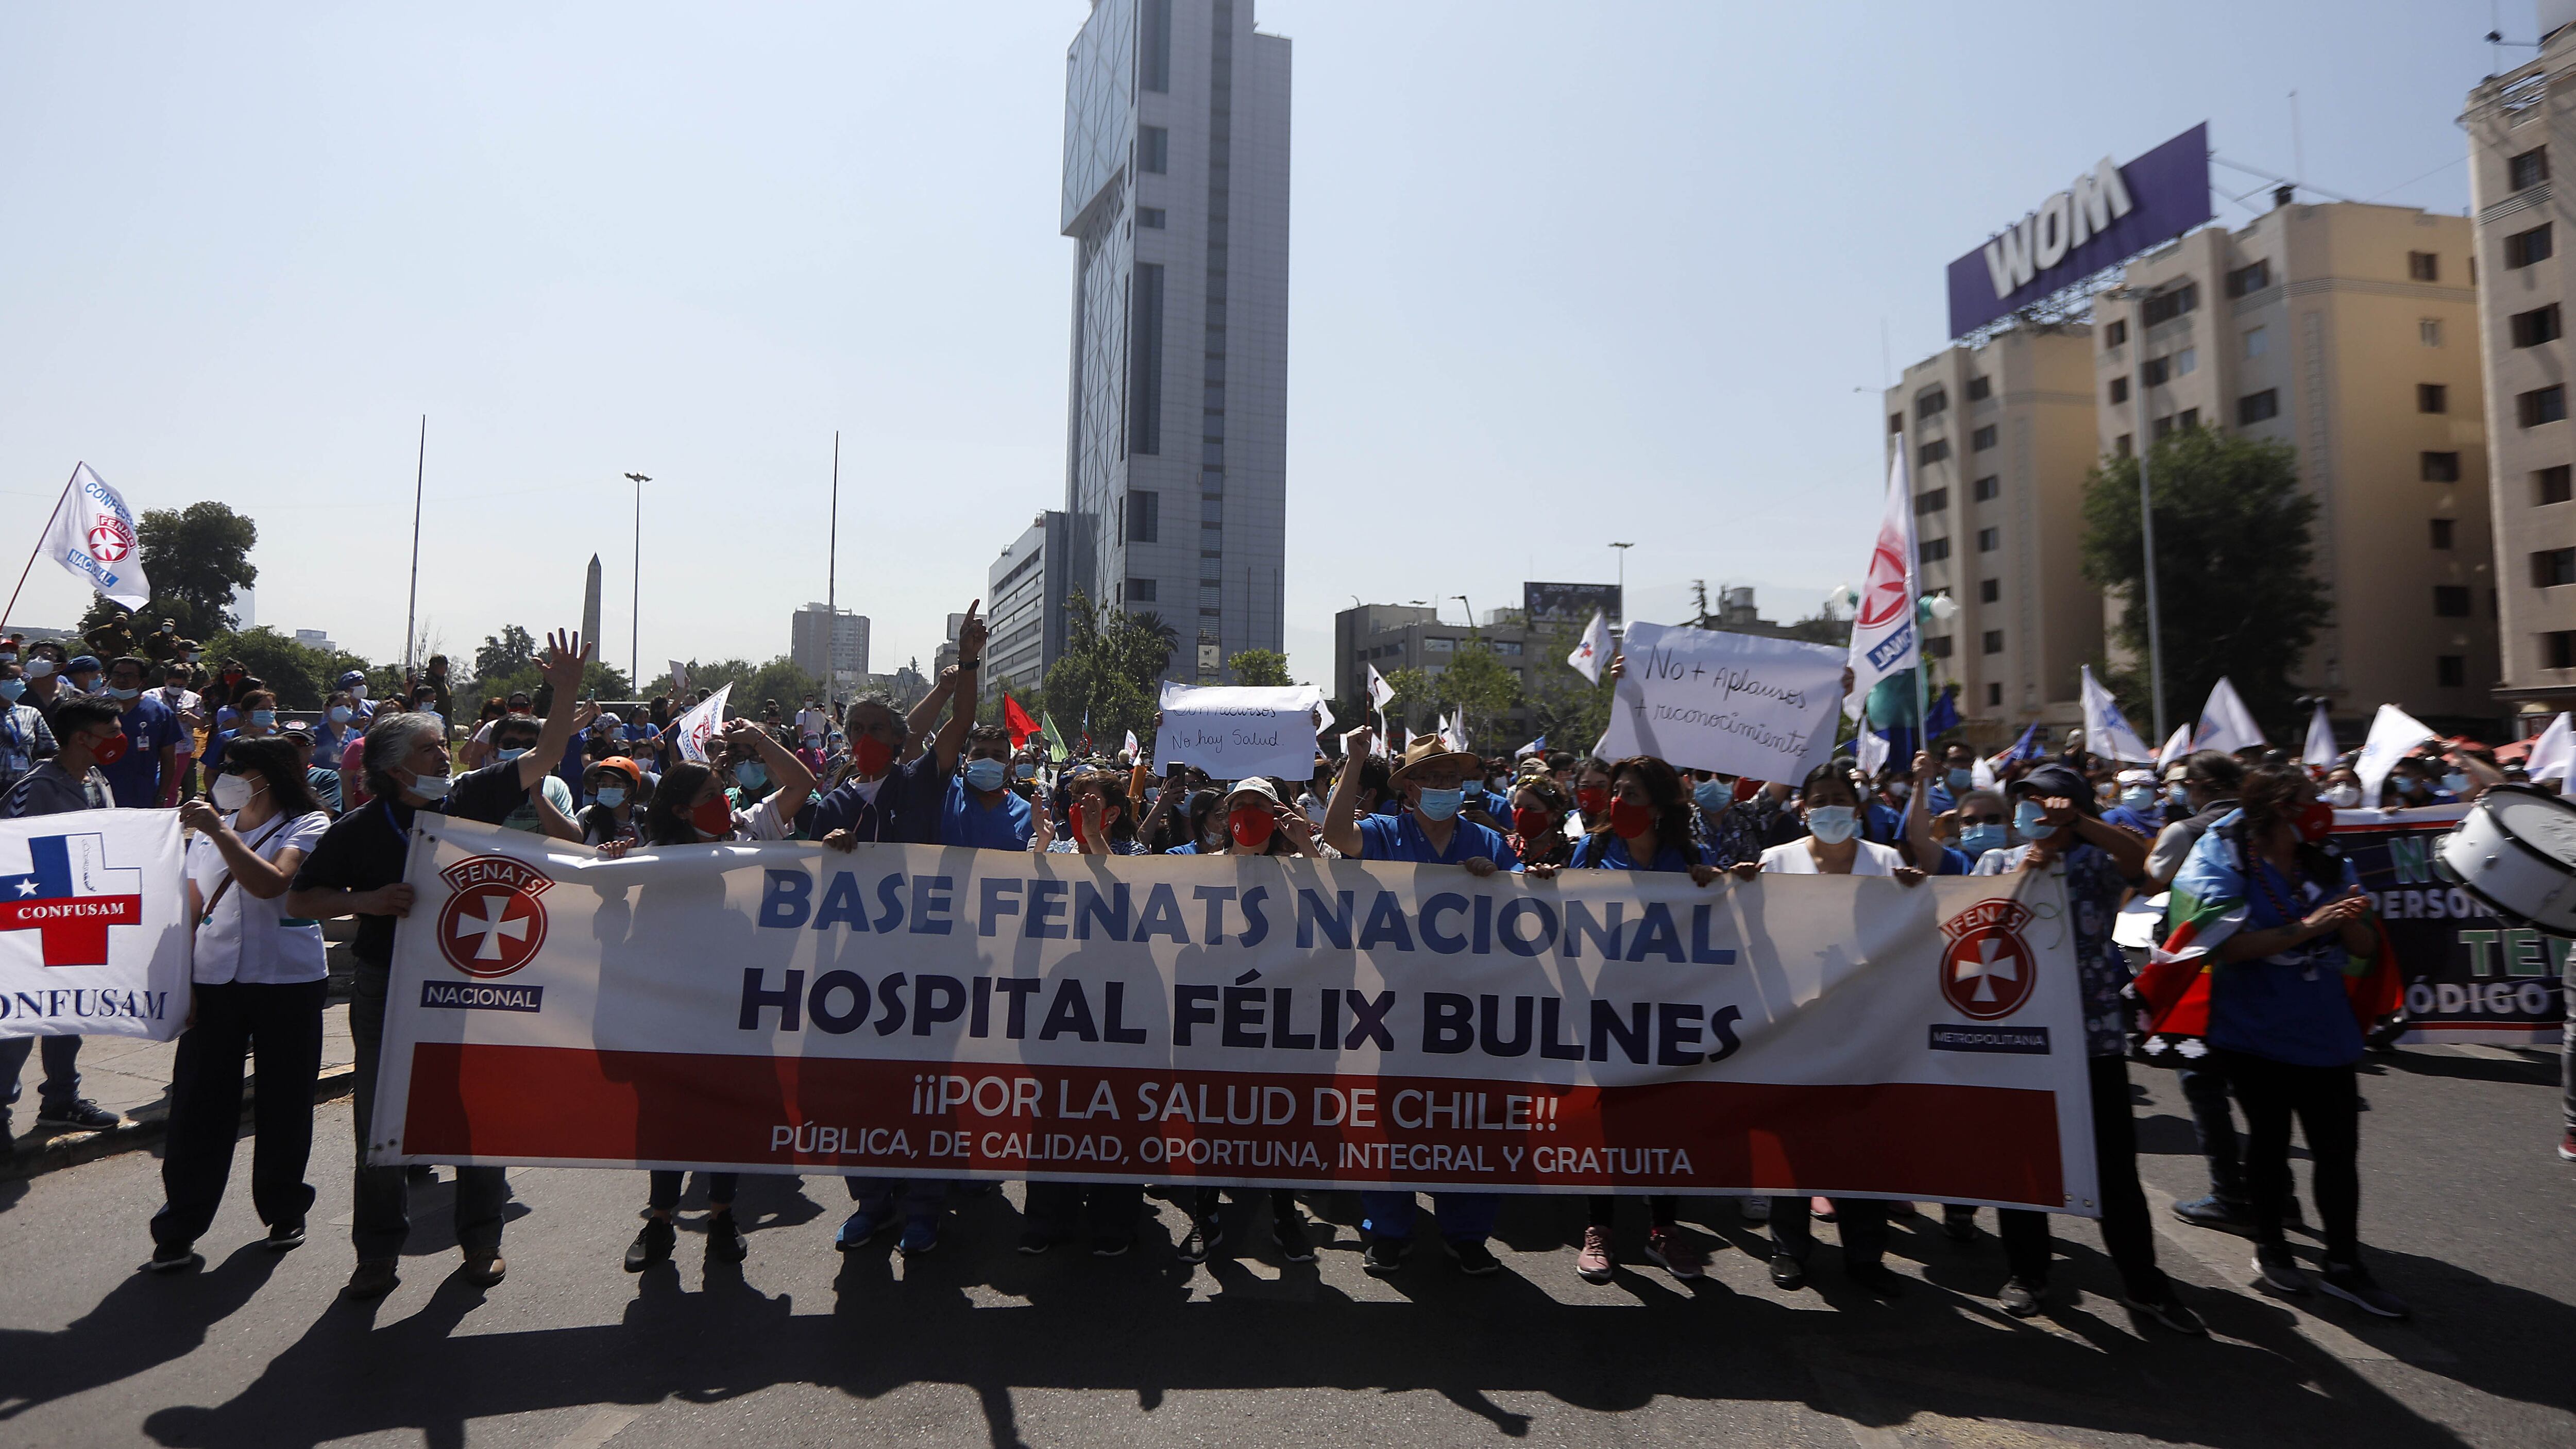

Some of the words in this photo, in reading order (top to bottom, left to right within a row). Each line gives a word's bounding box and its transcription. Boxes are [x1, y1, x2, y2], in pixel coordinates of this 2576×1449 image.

[1984, 155, 2133, 300] WOM
[1646, 645, 1684, 680] No
[1691, 661, 1705, 681] +
[1173, 697, 1209, 716] Sin
[1214, 704, 1276, 718] recursos
[1172, 730, 1190, 749] No
[1196, 729, 1223, 753] hay
[1232, 729, 1284, 747] Salud.
[453, 863, 541, 892] FENATS
[17, 903, 125, 919] CONFUSAM
[759, 869, 953, 935] BASE
[979, 878, 1268, 948] FENATS
[1296, 889, 1736, 965] NACIONAL
[427, 986, 538, 1007] NACIONAL
[2406, 975, 2549, 1014] ÓDIGO
[738, 968, 1147, 1044] HOSPITAL
[1173, 968, 1395, 1051] FÉLIX
[1422, 991, 1742, 1066] BULNES
[1933, 1032, 2046, 1046] METROPOLITANA
[912, 1074, 1043, 1117] ¡¡POR
[1058, 1079, 1121, 1120] LA
[1137, 1082, 1296, 1125] SALUD
[1313, 1087, 1376, 1128] DE
[1393, 1089, 1557, 1131] CHILE!!
[770, 1121, 918, 1159] PÚBLICA,
[929, 1131, 971, 1157] DE
[981, 1132, 1129, 1166] CALIDAD,
[1140, 1137, 1328, 1171] OPORTUNA,
[1338, 1142, 1494, 1172] INTEGRAL
[1503, 1146, 1523, 1172] Y
[1533, 1147, 1693, 1175] GRATUITA
